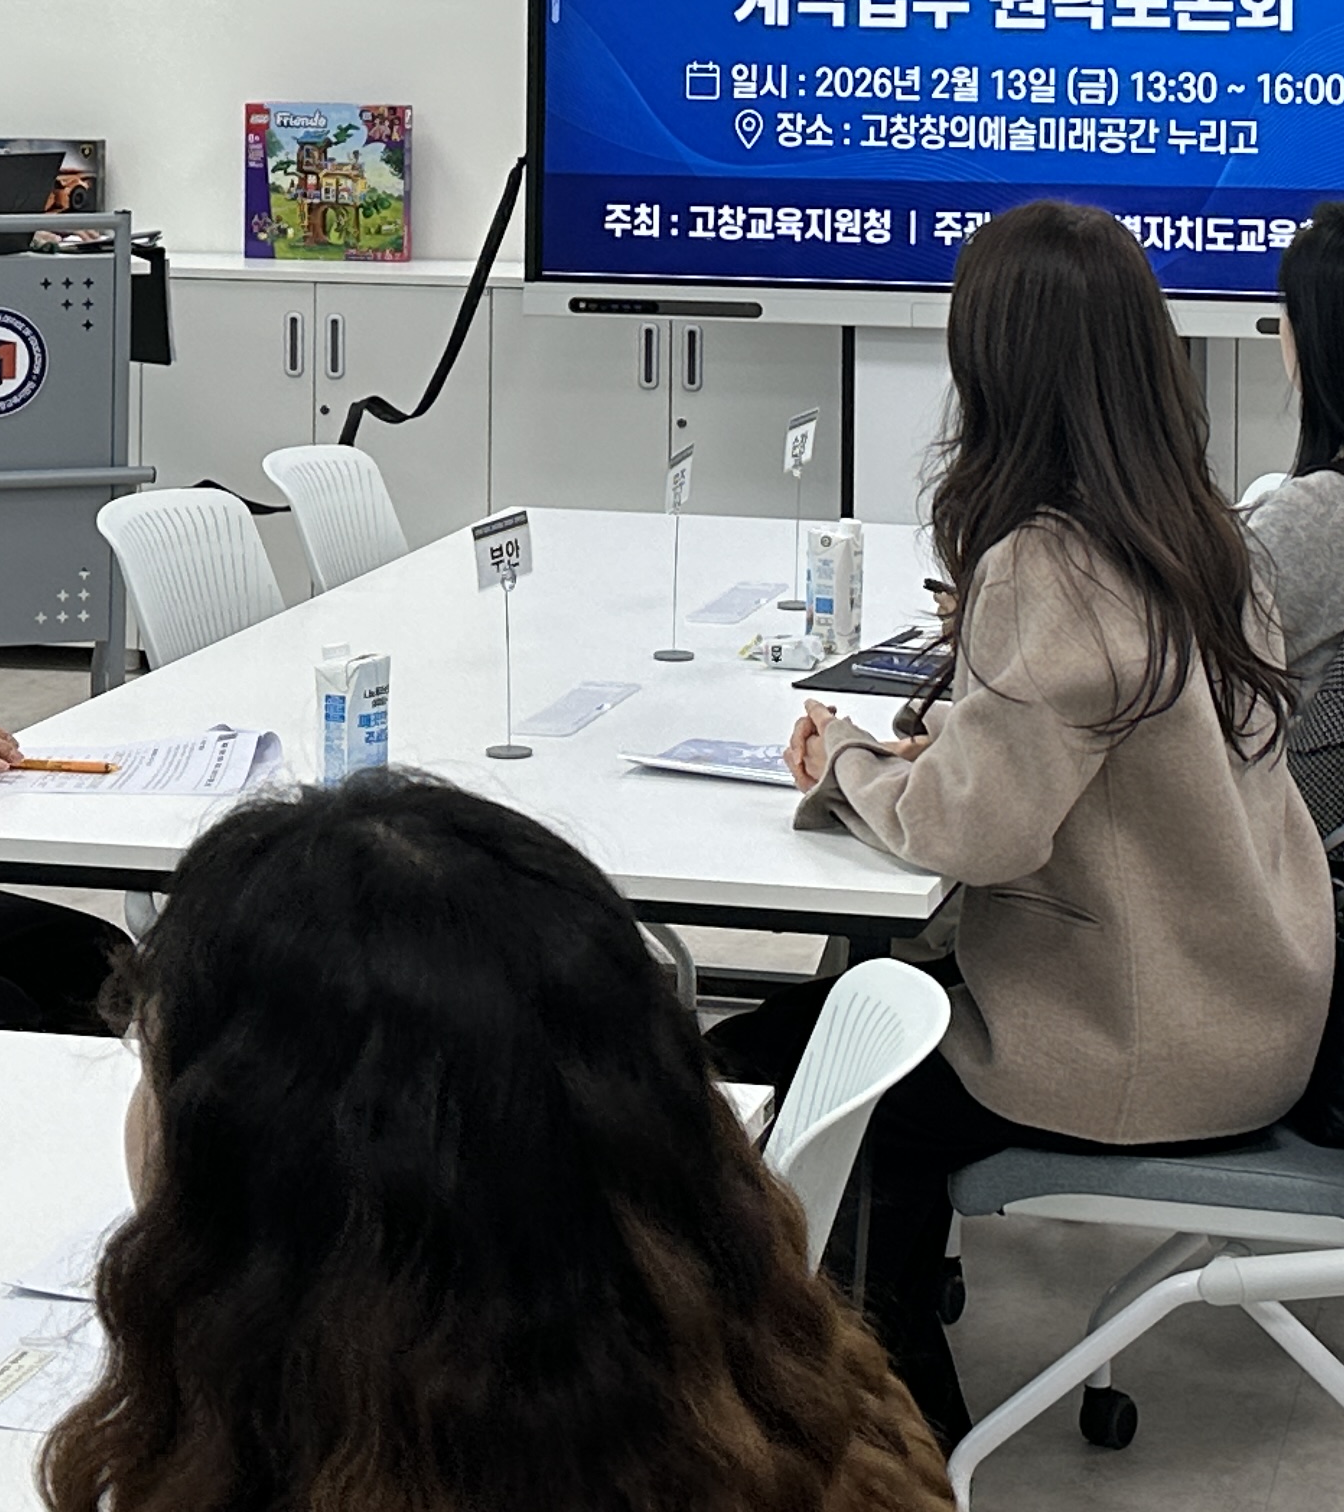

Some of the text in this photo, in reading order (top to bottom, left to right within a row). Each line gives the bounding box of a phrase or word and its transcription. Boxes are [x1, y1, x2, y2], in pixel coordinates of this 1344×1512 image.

[731, 63, 787, 99] 일시
[798, 74, 806, 96] :
[815, 65, 921, 102] 2026년
[931, 66, 979, 102] 2월
[991, 67, 1055, 104] 13일
[1067, 67, 1119, 106] (금)
[1130, 71, 1218, 103] 13:30
[1227, 84, 1246, 93] ~
[275, 109, 328, 128] Friends
[776, 112, 1259, 155] 장소 : 고창창의예술미래공간 누리고
[604, 203, 660, 238] 주최
[670, 214, 679, 236] :
[688, 204, 891, 244] 고창교육지원청
[490, 538, 520, 573] 부안
